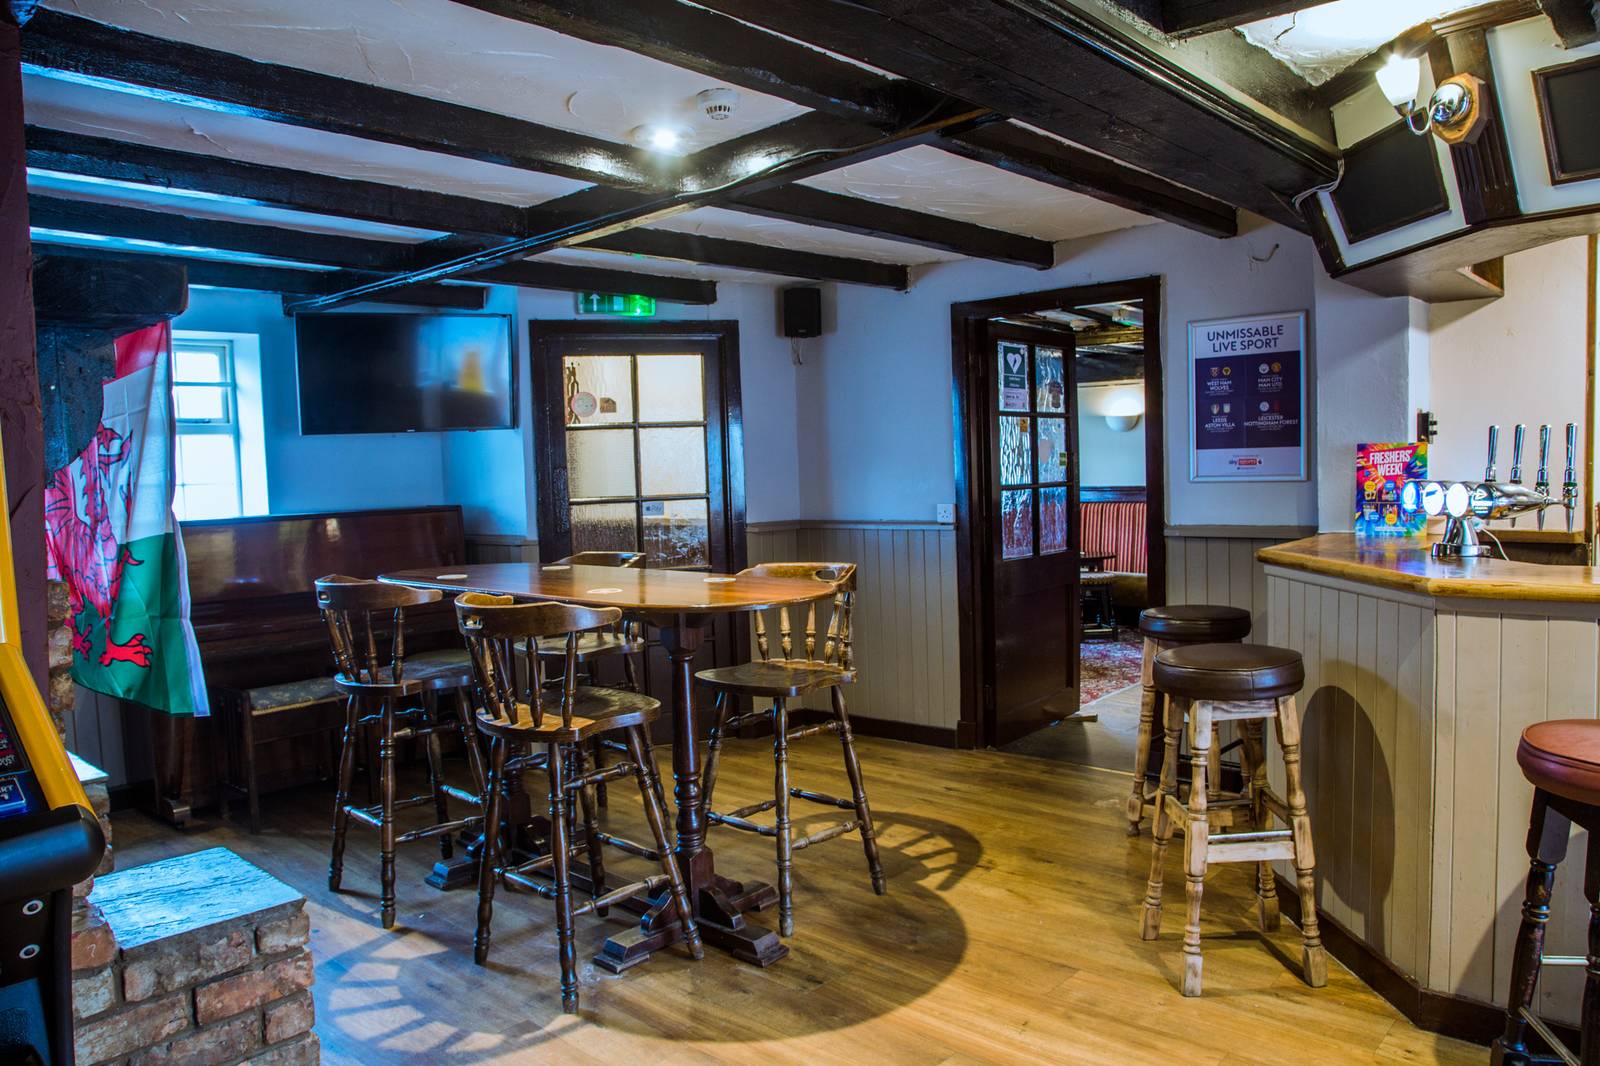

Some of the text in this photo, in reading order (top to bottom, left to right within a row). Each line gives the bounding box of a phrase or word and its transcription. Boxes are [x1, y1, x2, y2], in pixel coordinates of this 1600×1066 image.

[1207, 325, 1284, 342] UNMISSABLE
[1212, 338, 1279, 353] LIVE SPORT
[1370, 450, 1412, 465] FRESHERS'
[1377, 463, 1403, 476] WEEK!
